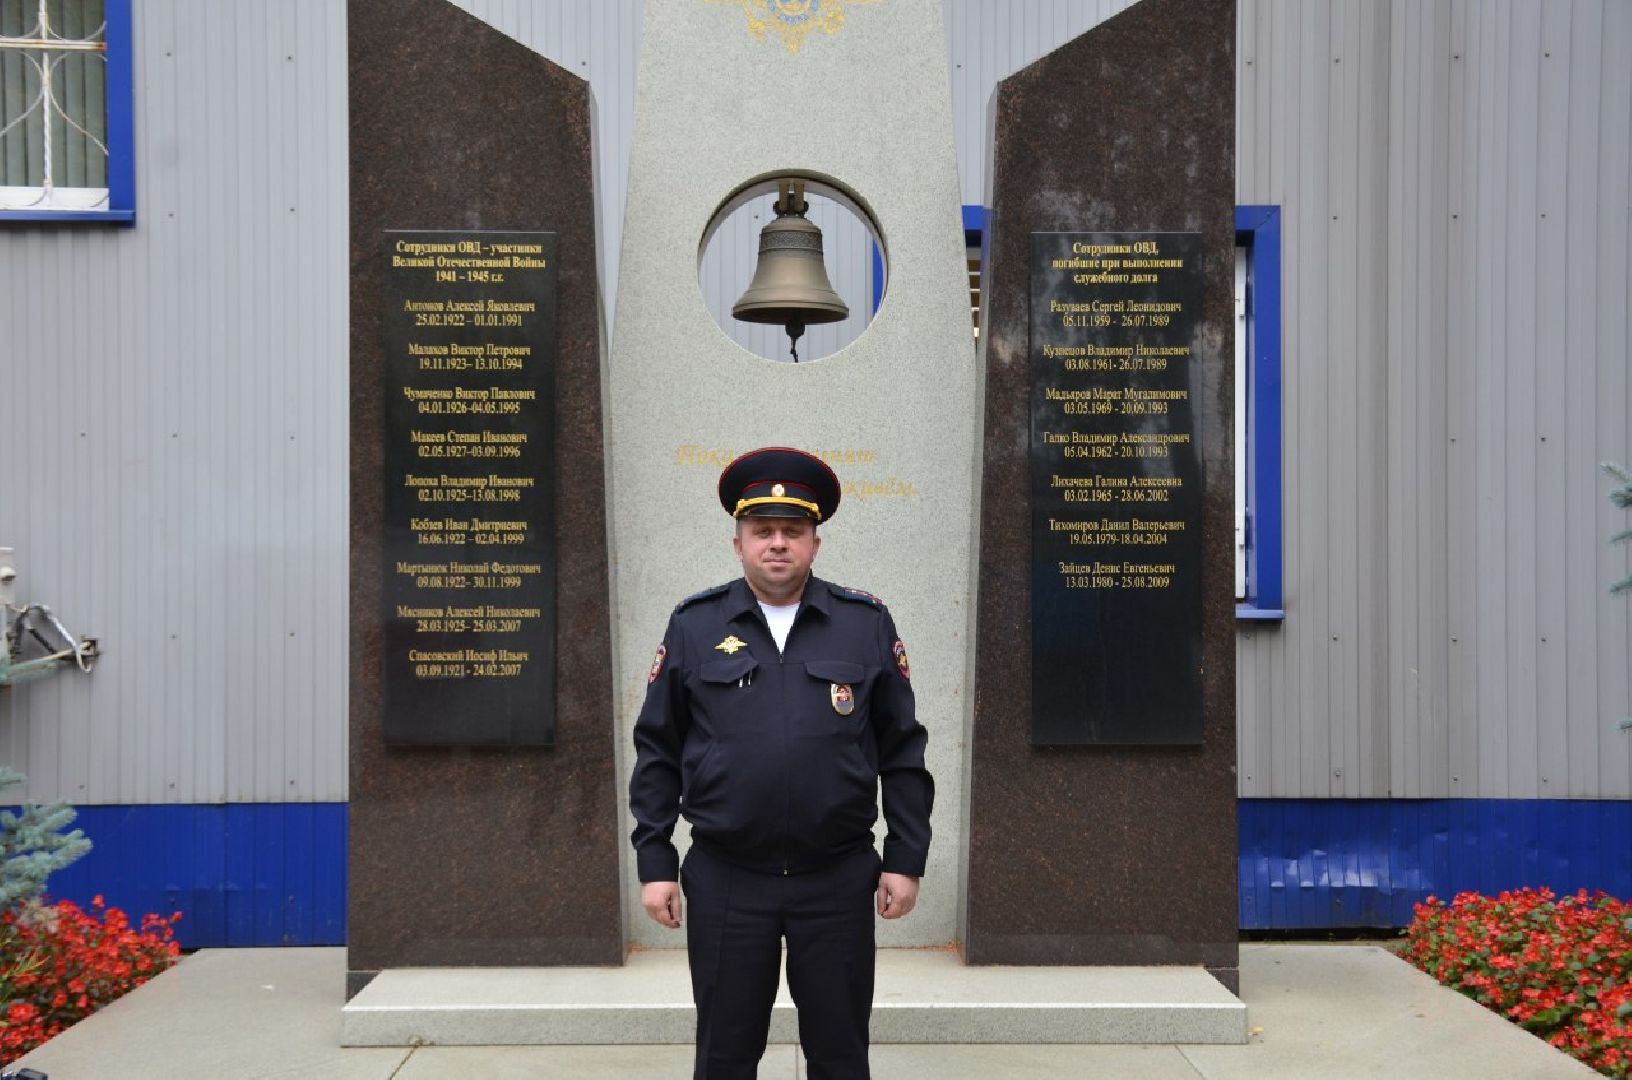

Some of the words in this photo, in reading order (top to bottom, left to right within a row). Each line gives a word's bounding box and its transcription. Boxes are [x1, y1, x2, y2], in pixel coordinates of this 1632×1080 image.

[396, 241, 456, 255] Сотрудники
[458, 242, 480, 254] ОВД
[490, 243, 541, 255] участники
[1073, 242, 1131, 256] Сотрудники
[1134, 242, 1158, 255] ОВД,
[393, 256, 434, 267] Великой
[437, 256, 510, 267] Отечественной
[513, 257, 545, 268] Войны
[1053, 257, 1100, 267] погибшие
[1102, 260, 1119, 271] при
[1123, 259, 1183, 267] выполнении
[436, 271, 456, 281] 1941
[468, 271, 488, 281] 1945
[1074, 272, 1128, 285] служебного
[1131, 274, 1157, 284] долга
[404, 300, 443, 311] Антонов
[446, 300, 484, 312] Алексей
[487, 300, 535, 312] Яковлевич
[1092, 300, 1123, 315] Сергей
[1127, 300, 1181, 312] Леонидович
[416, 314, 465, 326] 25.02.1922
[474, 314, 521, 326] 01.01.1991
[1063, 316, 1110, 326] 05.11.1959
[1122, 316, 1169, 326] 26.07.1989
[451, 344, 484, 359] Виктор
[487, 344, 530, 358] Петрович
[1044, 345, 1085, 358] Кузнецов
[1088, 345, 1134, 358] Владимир
[1136, 345, 1189, 355] Николаевич
[476, 359, 522, 369] 13.10.1994
[1120, 359, 1166, 369] 26.07.1989
[456, 387, 488, 402] Виктор
[490, 388, 535, 399] Павлович
[1046, 388, 1091, 401] Мадьяров
[1093, 388, 1122, 402] Марат
[1064, 403, 1113, 414] 03.05.1969
[1122, 403, 1167, 414] 20.09.1993
[411, 430, 446, 442] Макеев
[448, 431, 480, 442] Степан
[483, 431, 527, 442] Иванович
[1072, 432, 1118, 445] Владимир
[1120, 432, 1189, 445] Александрович
[1065, 447, 1112, 457] 05.04.1962
[1122, 447, 1167, 457] 20.10.1993
[441, 475, 486, 489] Владимир
[489, 475, 534, 486] Иванович
[1051, 475, 1092, 487] Лихачева
[1096, 475, 1127, 486] Галина
[1130, 475, 1181, 486] Алексеевна
[1065, 490, 1112, 501] 03.02.1965
[1122, 490, 1168, 501] 28.06.2002
[446, 519, 467, 530] Иван
[470, 519, 527, 532] Дмитриевич
[1049, 519, 1099, 532] Тихомиров
[1101, 520, 1129, 532] Данил
[1132, 520, 1185, 532] Валерьевич
[418, 534, 465, 544] 16.06.1922
[476, 534, 524, 544] 02.04.1999
[450, 562, 488, 573] Николай
[491, 562, 540, 575] Федотович
[1059, 563, 1090, 574] Зайцев
[1093, 563, 1120, 574] Денис
[1124, 563, 1175, 574] Евгеньевич
[474, 577, 521, 588] 30.11.1999
[1066, 577, 1113, 588] 13.03.1980
[1122, 577, 1169, 588] 25.08.2009
[446, 606, 483, 617] Алексей
[487, 606, 540, 618] Николаевич
[473, 620, 521, 632] 25.03.2007
[466, 650, 497, 664] Иосиф
[499, 650, 528, 661] Ильич
[416, 665, 464, 676] 03.09.1921
[474, 665, 521, 676] 24.02.2007
